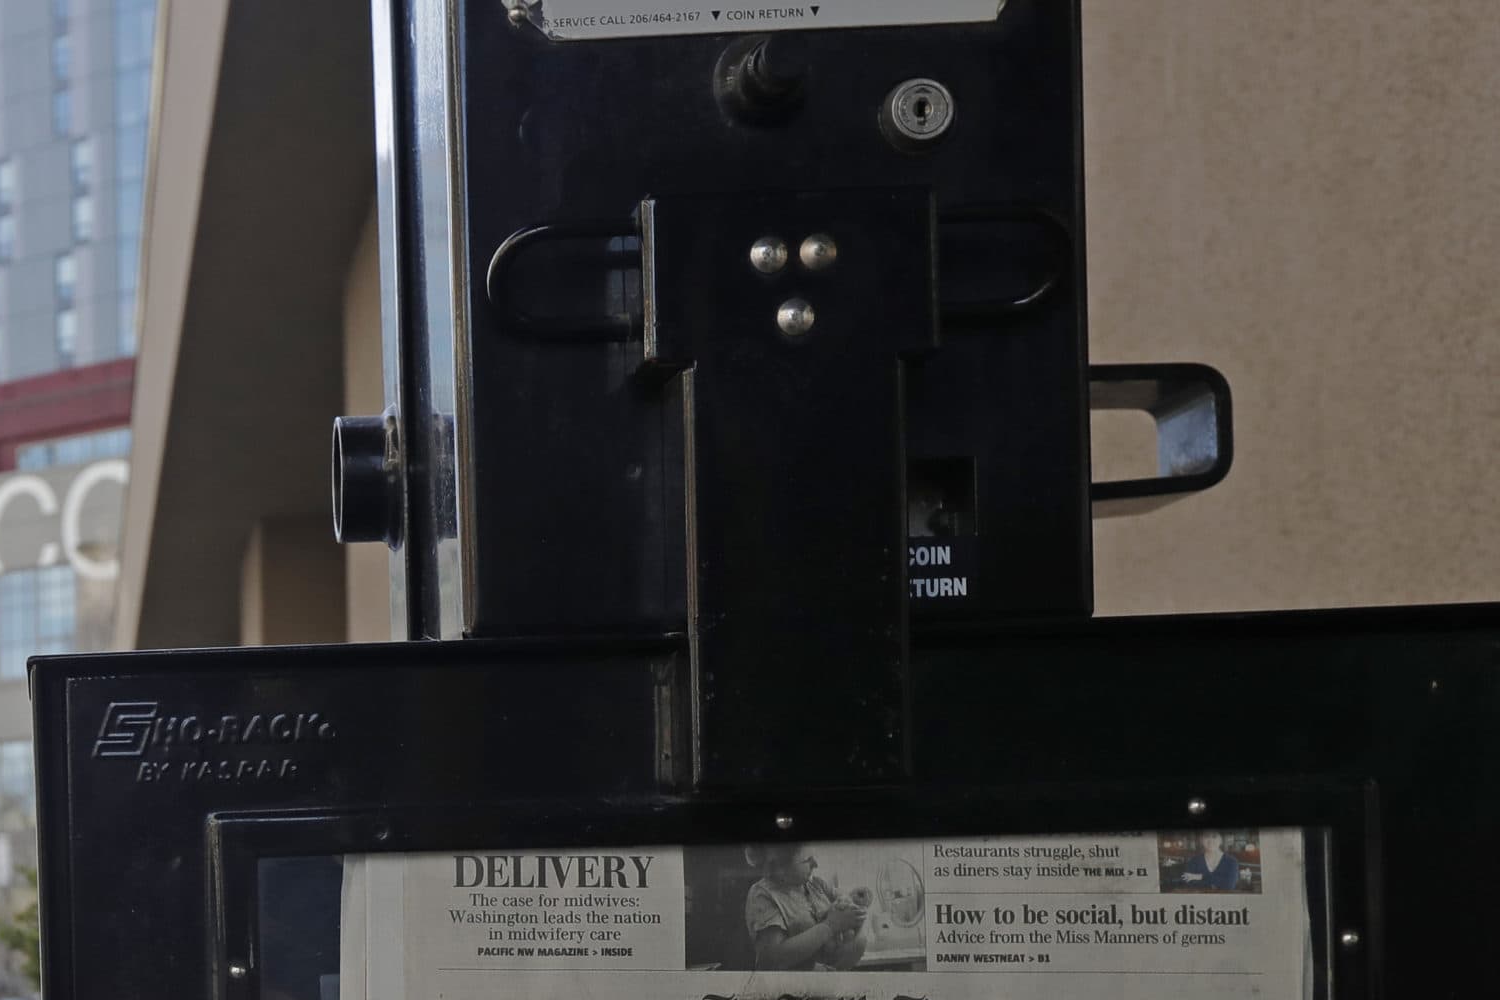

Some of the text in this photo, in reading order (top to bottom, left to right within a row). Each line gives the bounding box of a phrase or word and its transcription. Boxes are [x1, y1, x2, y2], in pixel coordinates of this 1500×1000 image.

[553, 16, 595, 27] SERVICE
[599, 14, 625, 25] CALL
[629, 11, 700, 24] 206/464-2167
[726, 7, 803, 20] COIN RETURN
[933, 843, 1119, 861] Restaurants struggle, shut
[450, 855, 654, 888] DELIVERY
[934, 866, 949, 876] as
[953, 862, 999, 876] diners
[1003, 865, 1032, 880] stay
[1036, 863, 1080, 877] inside
[468, 893, 639, 907] The case for midwives:
[448, 909, 660, 927] Washington leads the nation
[935, 904, 1249, 928] How to be social, but distant
[489, 927, 621, 943] in midwifery care
[936, 929, 1225, 947] Advice from the Miss Manners of germs
[477, 947, 632, 956] PACIFIC NW MAGAZINE INSIDE
[936, 953, 1050, 963] DANNY WESTNEAT B1
